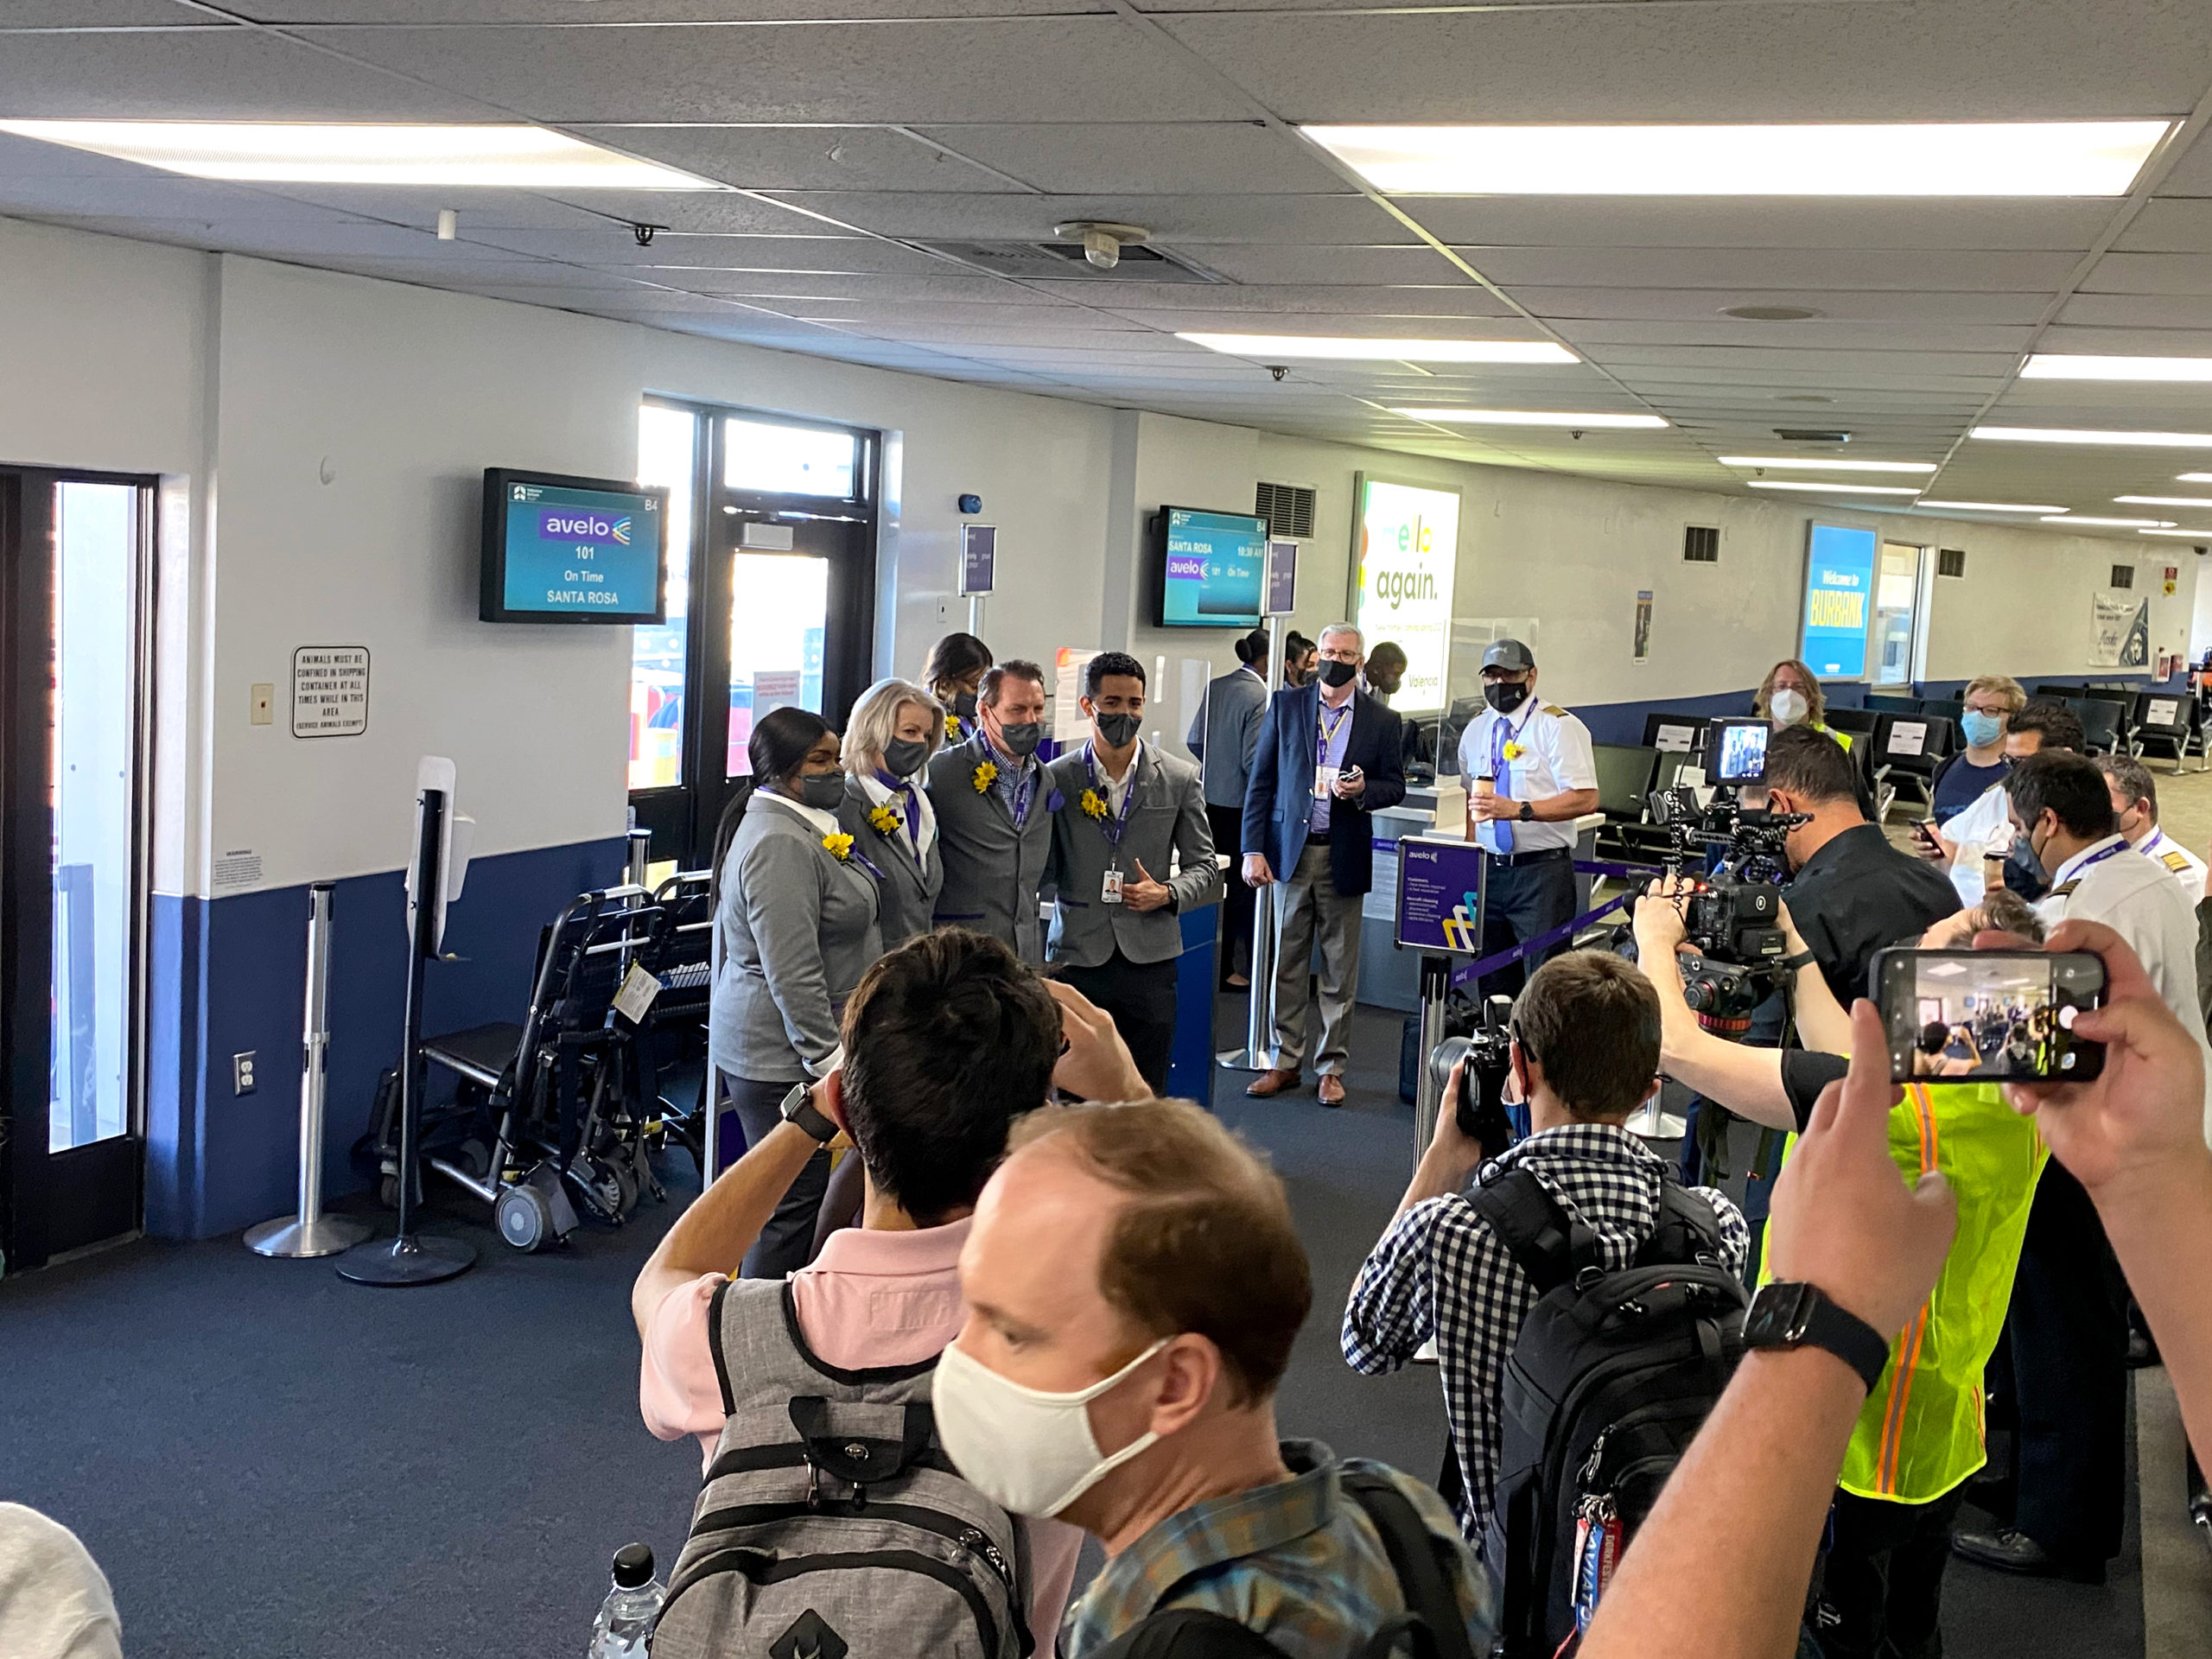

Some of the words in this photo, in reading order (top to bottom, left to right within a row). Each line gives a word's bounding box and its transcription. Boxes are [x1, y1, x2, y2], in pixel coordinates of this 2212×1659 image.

[645, 499, 658, 512] B4
[546, 517, 609, 537] avelo
[1382, 514, 1432, 553] ello
[575, 546, 594, 561] 101
[1169, 540, 1193, 554] SANTA
[1193, 542, 1212, 555] ROSA
[1170, 560, 1199, 575] avelo
[1227, 566, 1237, 577] On
[1237, 568, 1249, 578] Time
[564, 570, 579, 582] On
[581, 571, 604, 582] Time
[1822, 569, 1851, 586] Welcome
[1852, 574, 1859, 587] to
[1376, 562, 1438, 610] again.
[547, 590, 586, 603] SANTA
[588, 591, 619, 605] ROSA
[1809, 589, 1865, 628] BURBANK
[302, 655, 331, 664] ANIMALS
[334, 655, 352, 664] MUST
[354, 654, 363, 664] BE
[297, 668, 327, 677] CONFINED
[330, 668, 336, 677] IN
[339, 668, 365, 677] SHIPPING
[301, 681, 337, 690] CONTAINER
[340, 681, 347, 690] AT
[350, 681, 361, 690] ALL
[1408, 673, 1438, 688] Valencia
[298, 695, 317, 704] TIMES
[321, 695, 339, 703] WHILE
[341, 694, 347, 702] IN
[350, 694, 364, 702] THIS
[322, 708, 339, 716] AREA
[1408, 850, 1430, 860] avelo
